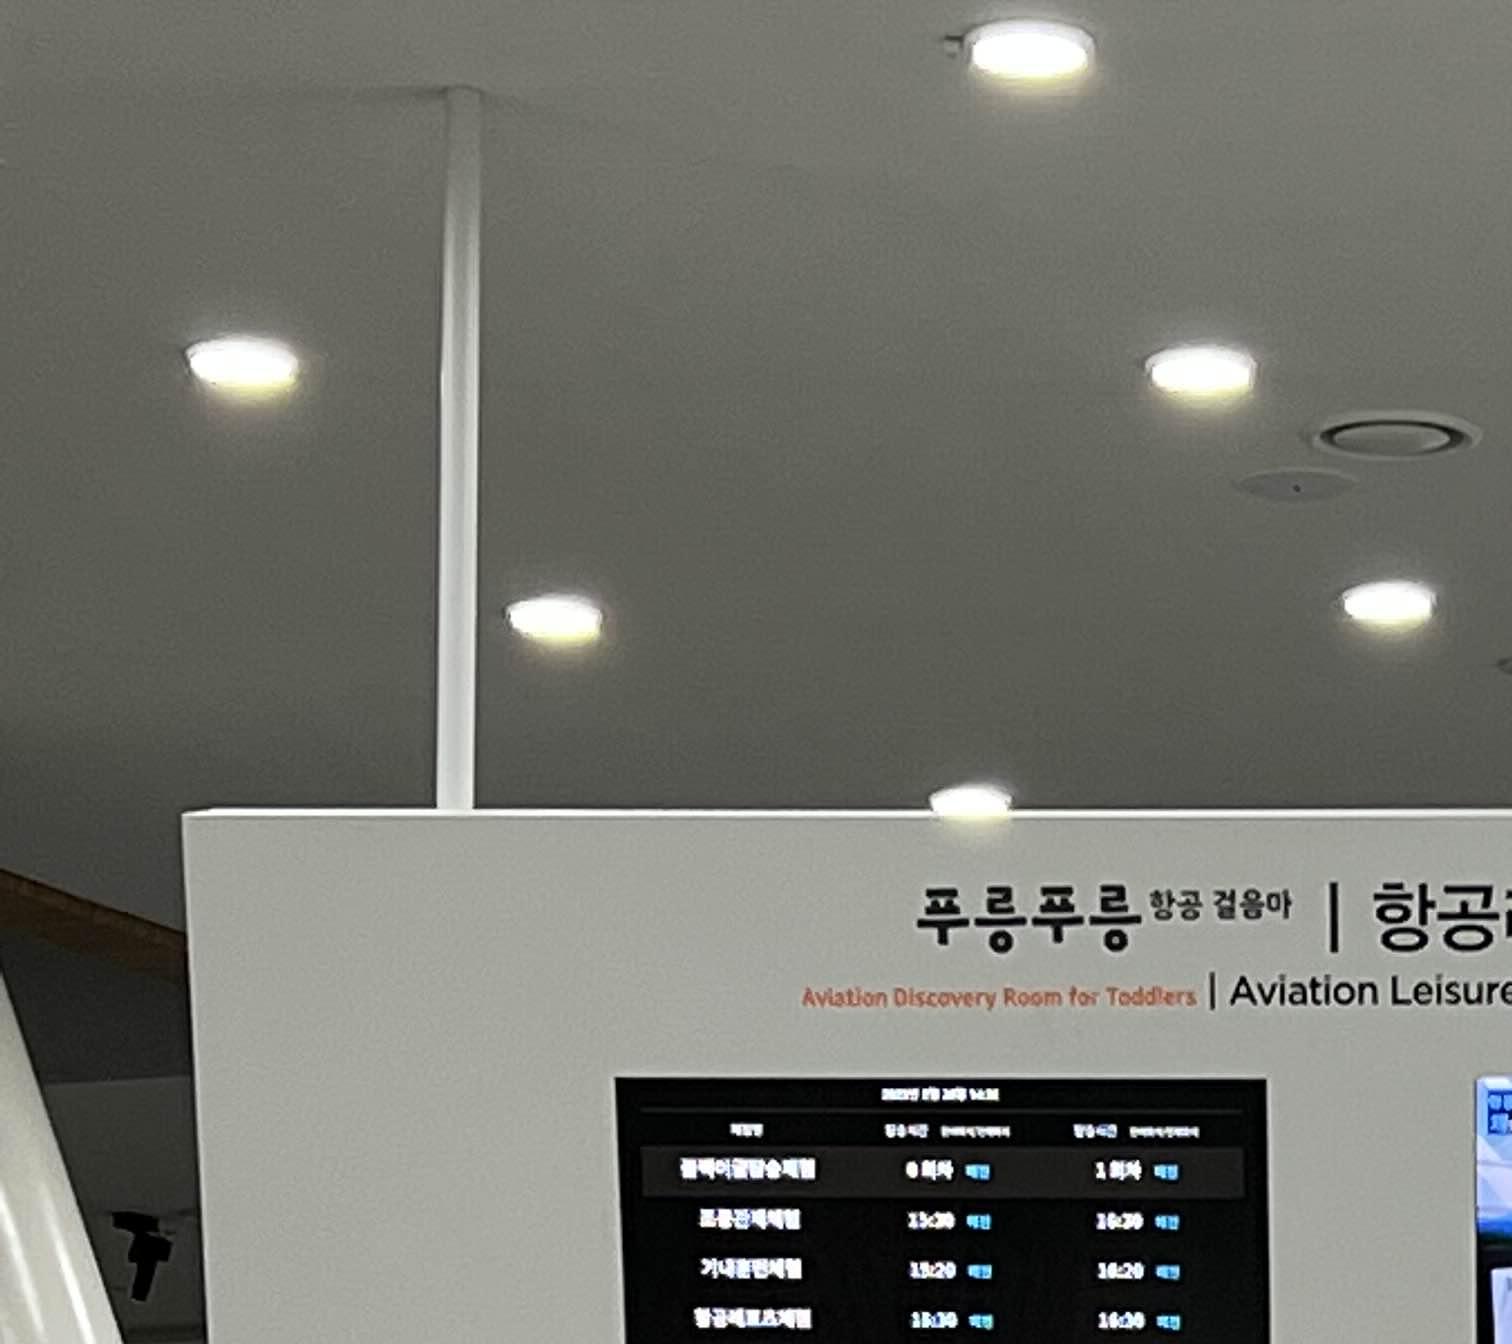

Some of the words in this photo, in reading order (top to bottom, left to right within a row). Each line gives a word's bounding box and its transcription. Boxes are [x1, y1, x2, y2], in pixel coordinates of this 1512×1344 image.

[917, 885, 1142, 953] 푸릉푸릉
[1149, 888, 1203, 921] 항공
[1211, 888, 1293, 920] 걸음마
[802, 986, 888, 1008] Aviation
[894, 986, 996, 1012] Discovery
[1003, 988, 1063, 1008] Room
[1068, 986, 1099, 1008] for
[1106, 986, 1198, 1008] Toddlers
[1230, 975, 1378, 1007] Aviation
